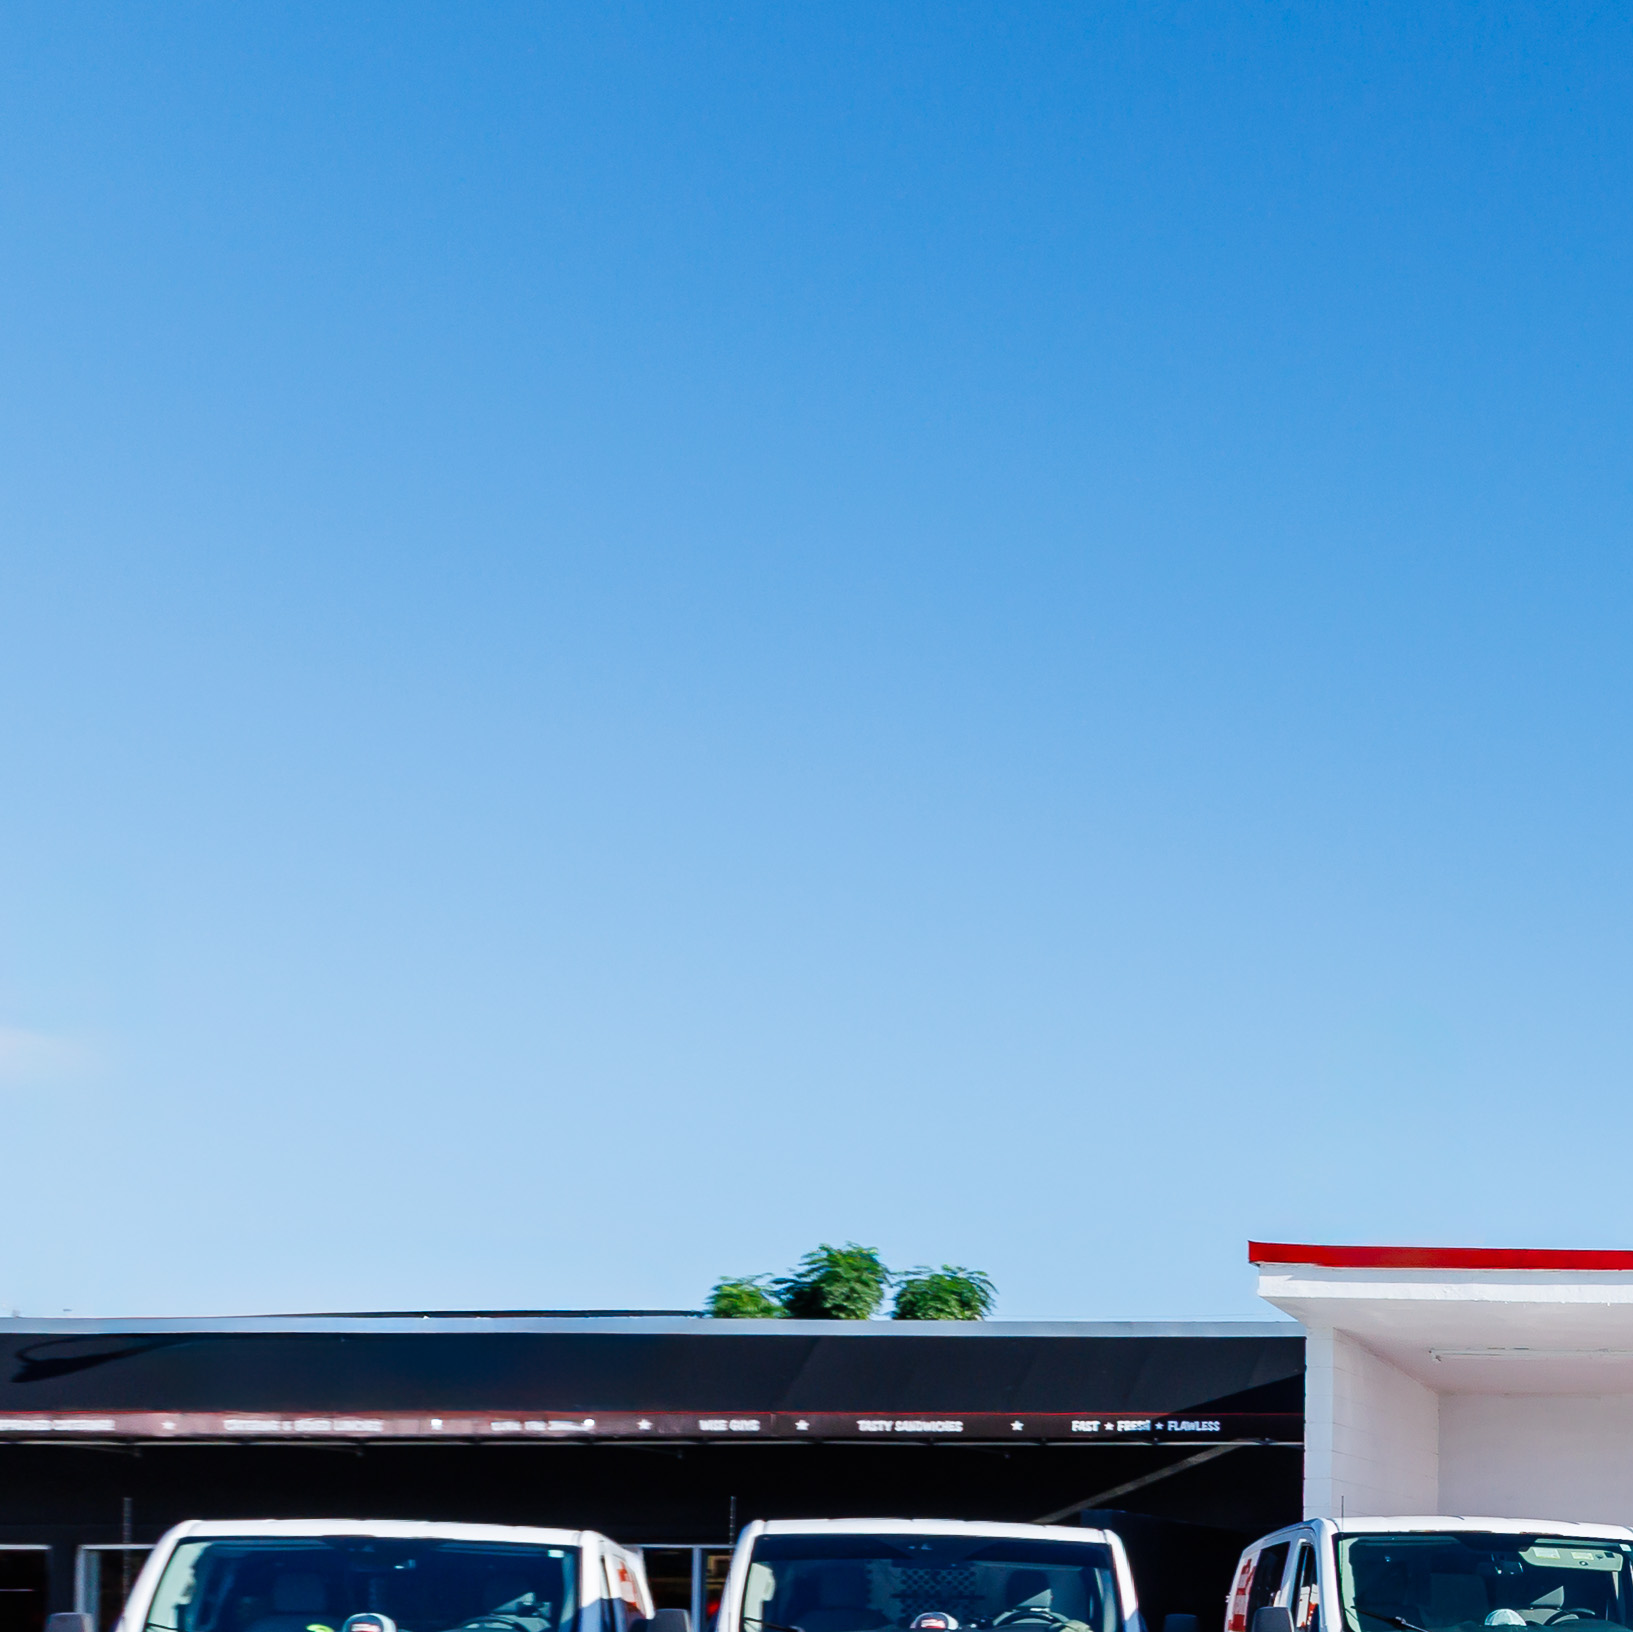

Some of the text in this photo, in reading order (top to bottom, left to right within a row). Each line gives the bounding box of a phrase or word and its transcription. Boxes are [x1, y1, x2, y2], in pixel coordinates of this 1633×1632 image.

[1071, 1420, 1221, 1432] FAST FRESH FLAWLESS
